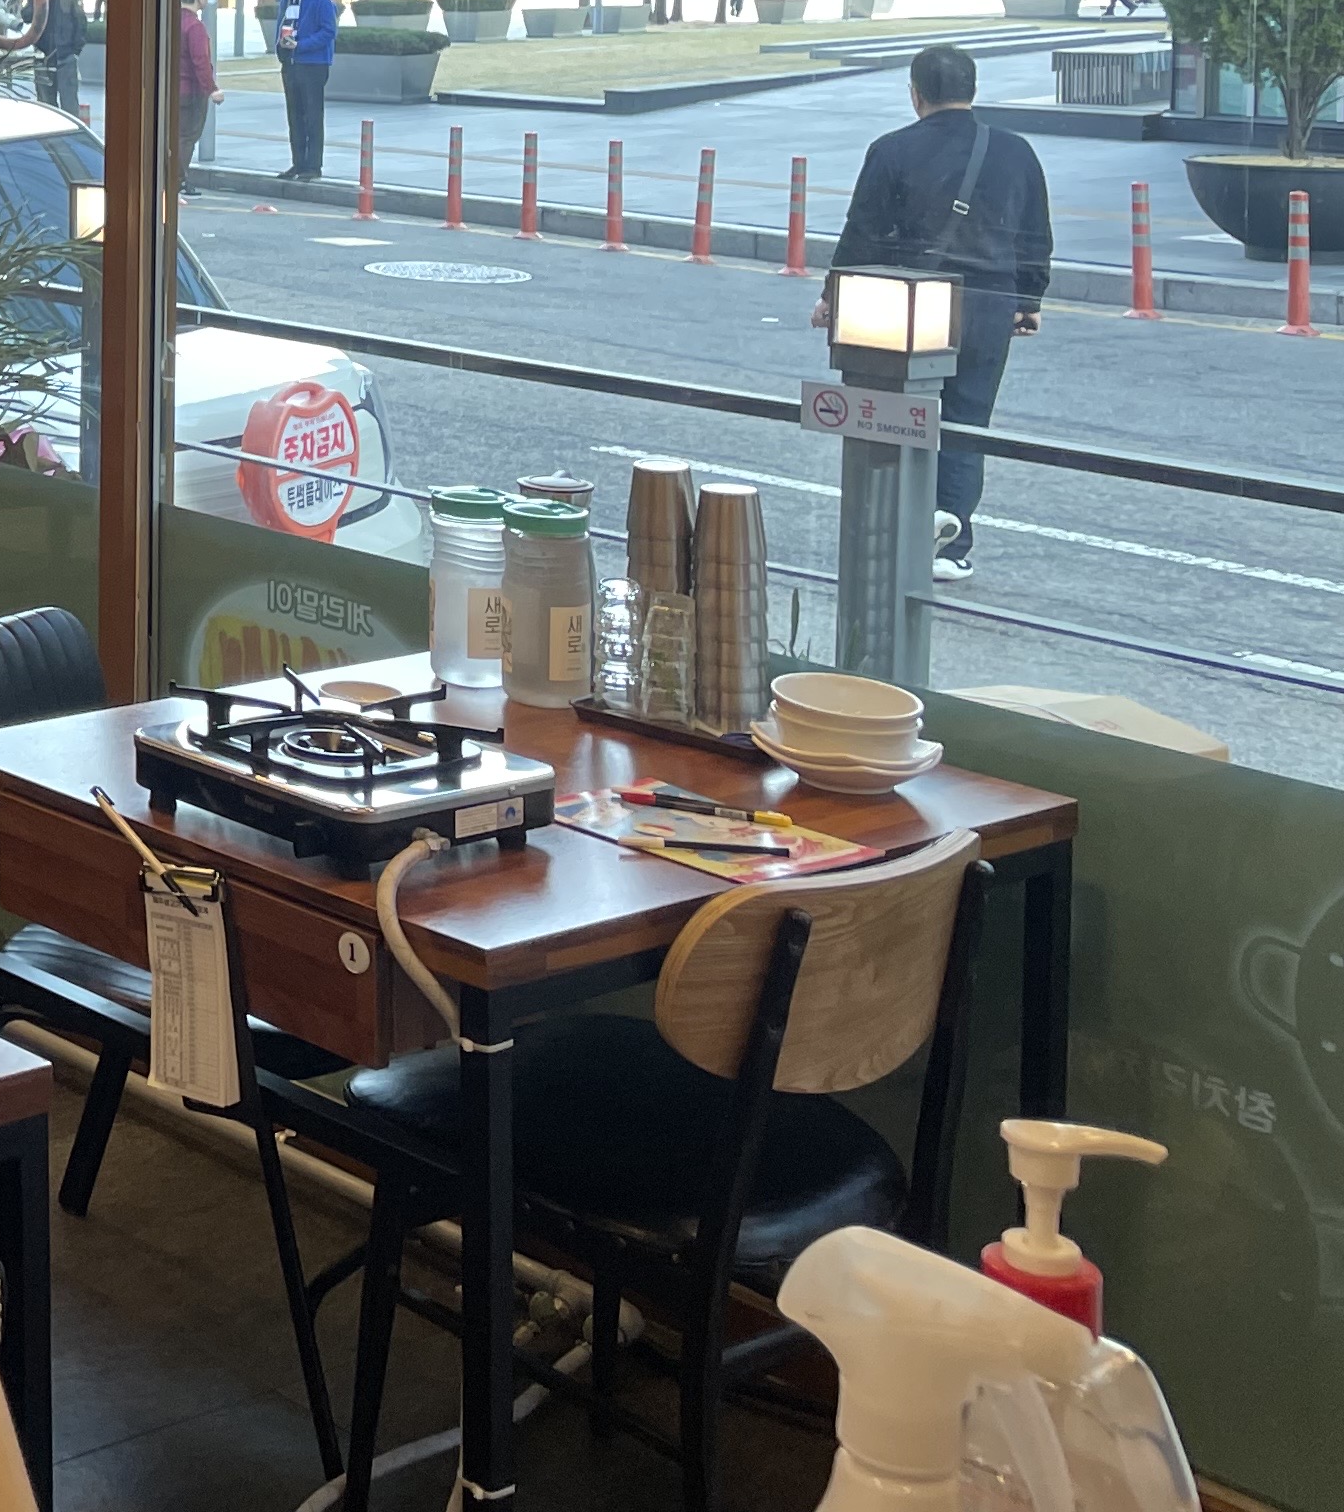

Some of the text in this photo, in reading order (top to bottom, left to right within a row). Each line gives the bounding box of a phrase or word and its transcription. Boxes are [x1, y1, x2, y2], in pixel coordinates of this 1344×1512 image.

[284, 421, 345, 463] 주차금지
[857, 420, 926, 439] NO SMOKING
